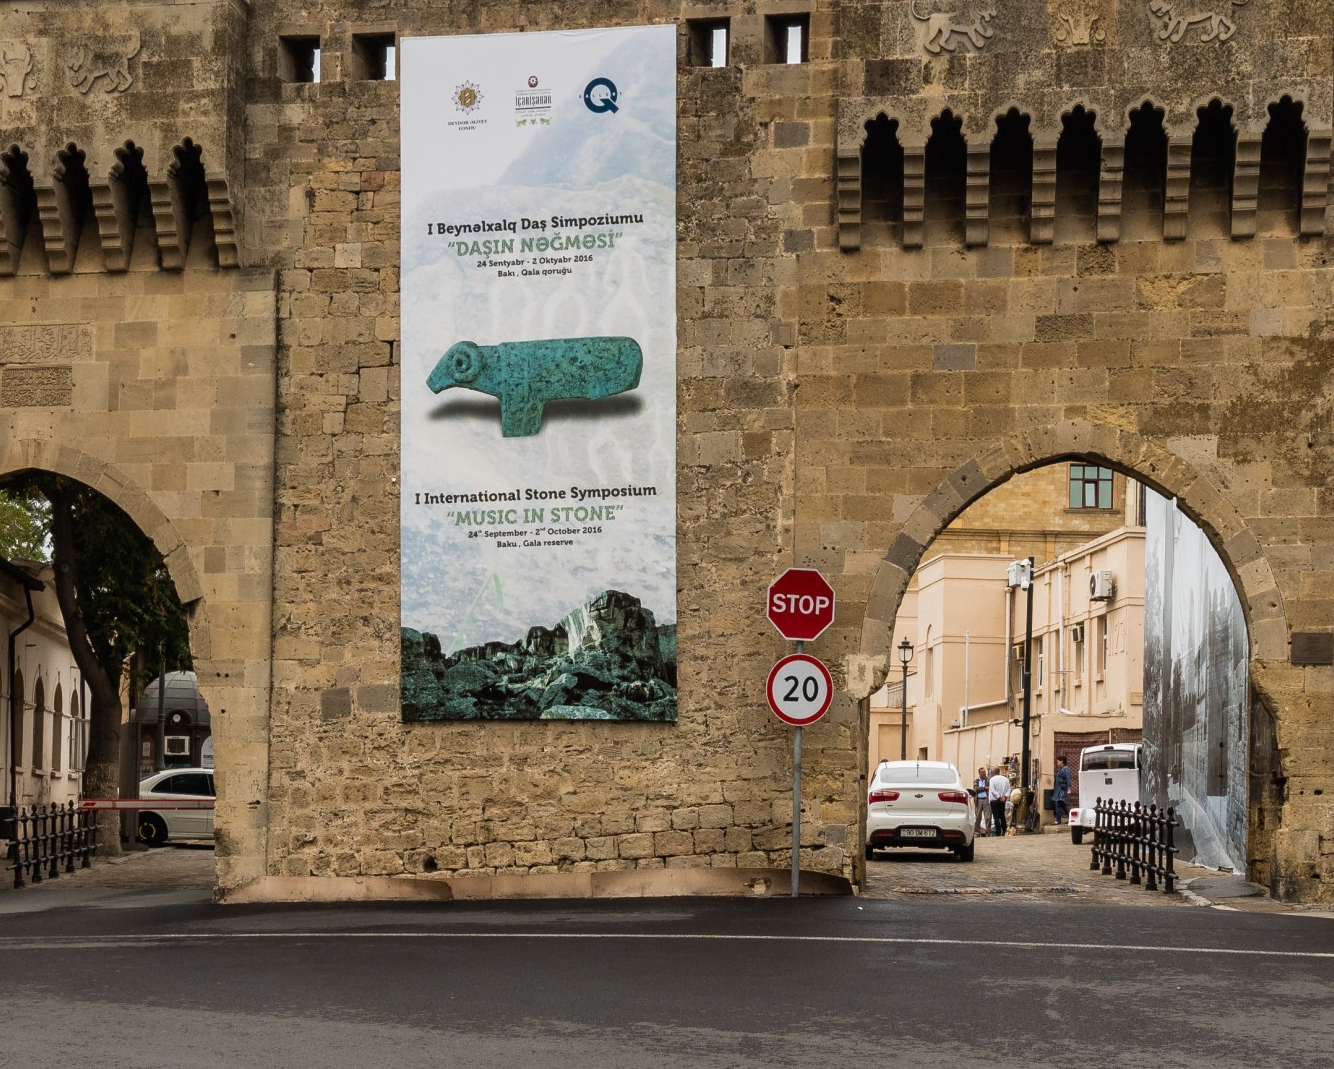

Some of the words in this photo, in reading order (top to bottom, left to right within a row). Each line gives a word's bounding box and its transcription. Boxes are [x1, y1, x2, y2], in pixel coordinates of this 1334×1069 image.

[427, 223, 433, 235] I
[437, 219, 517, 237] Beynəlxalq
[520, 218, 547, 232] Daş
[551, 213, 644, 230] Simpoziumu
[476, 260, 487, 268] 24
[488, 258, 525, 268] Sentyabr
[532, 257, 538, 265] 2
[539, 255, 572, 266] Oktyabr
[573, 254, 594, 263] 2016
[521, 268, 541, 277] Qala
[541, 266, 573, 277] qoruğu
[415, 493, 421, 505] I
[424, 489, 521, 505] International
[525, 488, 567, 501] Stone
[570, 484, 657, 501] Symposium
[523, 507, 545, 524] IN
[484, 529, 528, 539] September
[547, 527, 581, 536] October
[582, 526, 603, 535] 2016
[523, 539, 542, 547] Gala
[543, 539, 574, 547] reserve
[772, 593, 830, 615] STOP
[783, 675, 819, 703] 20
